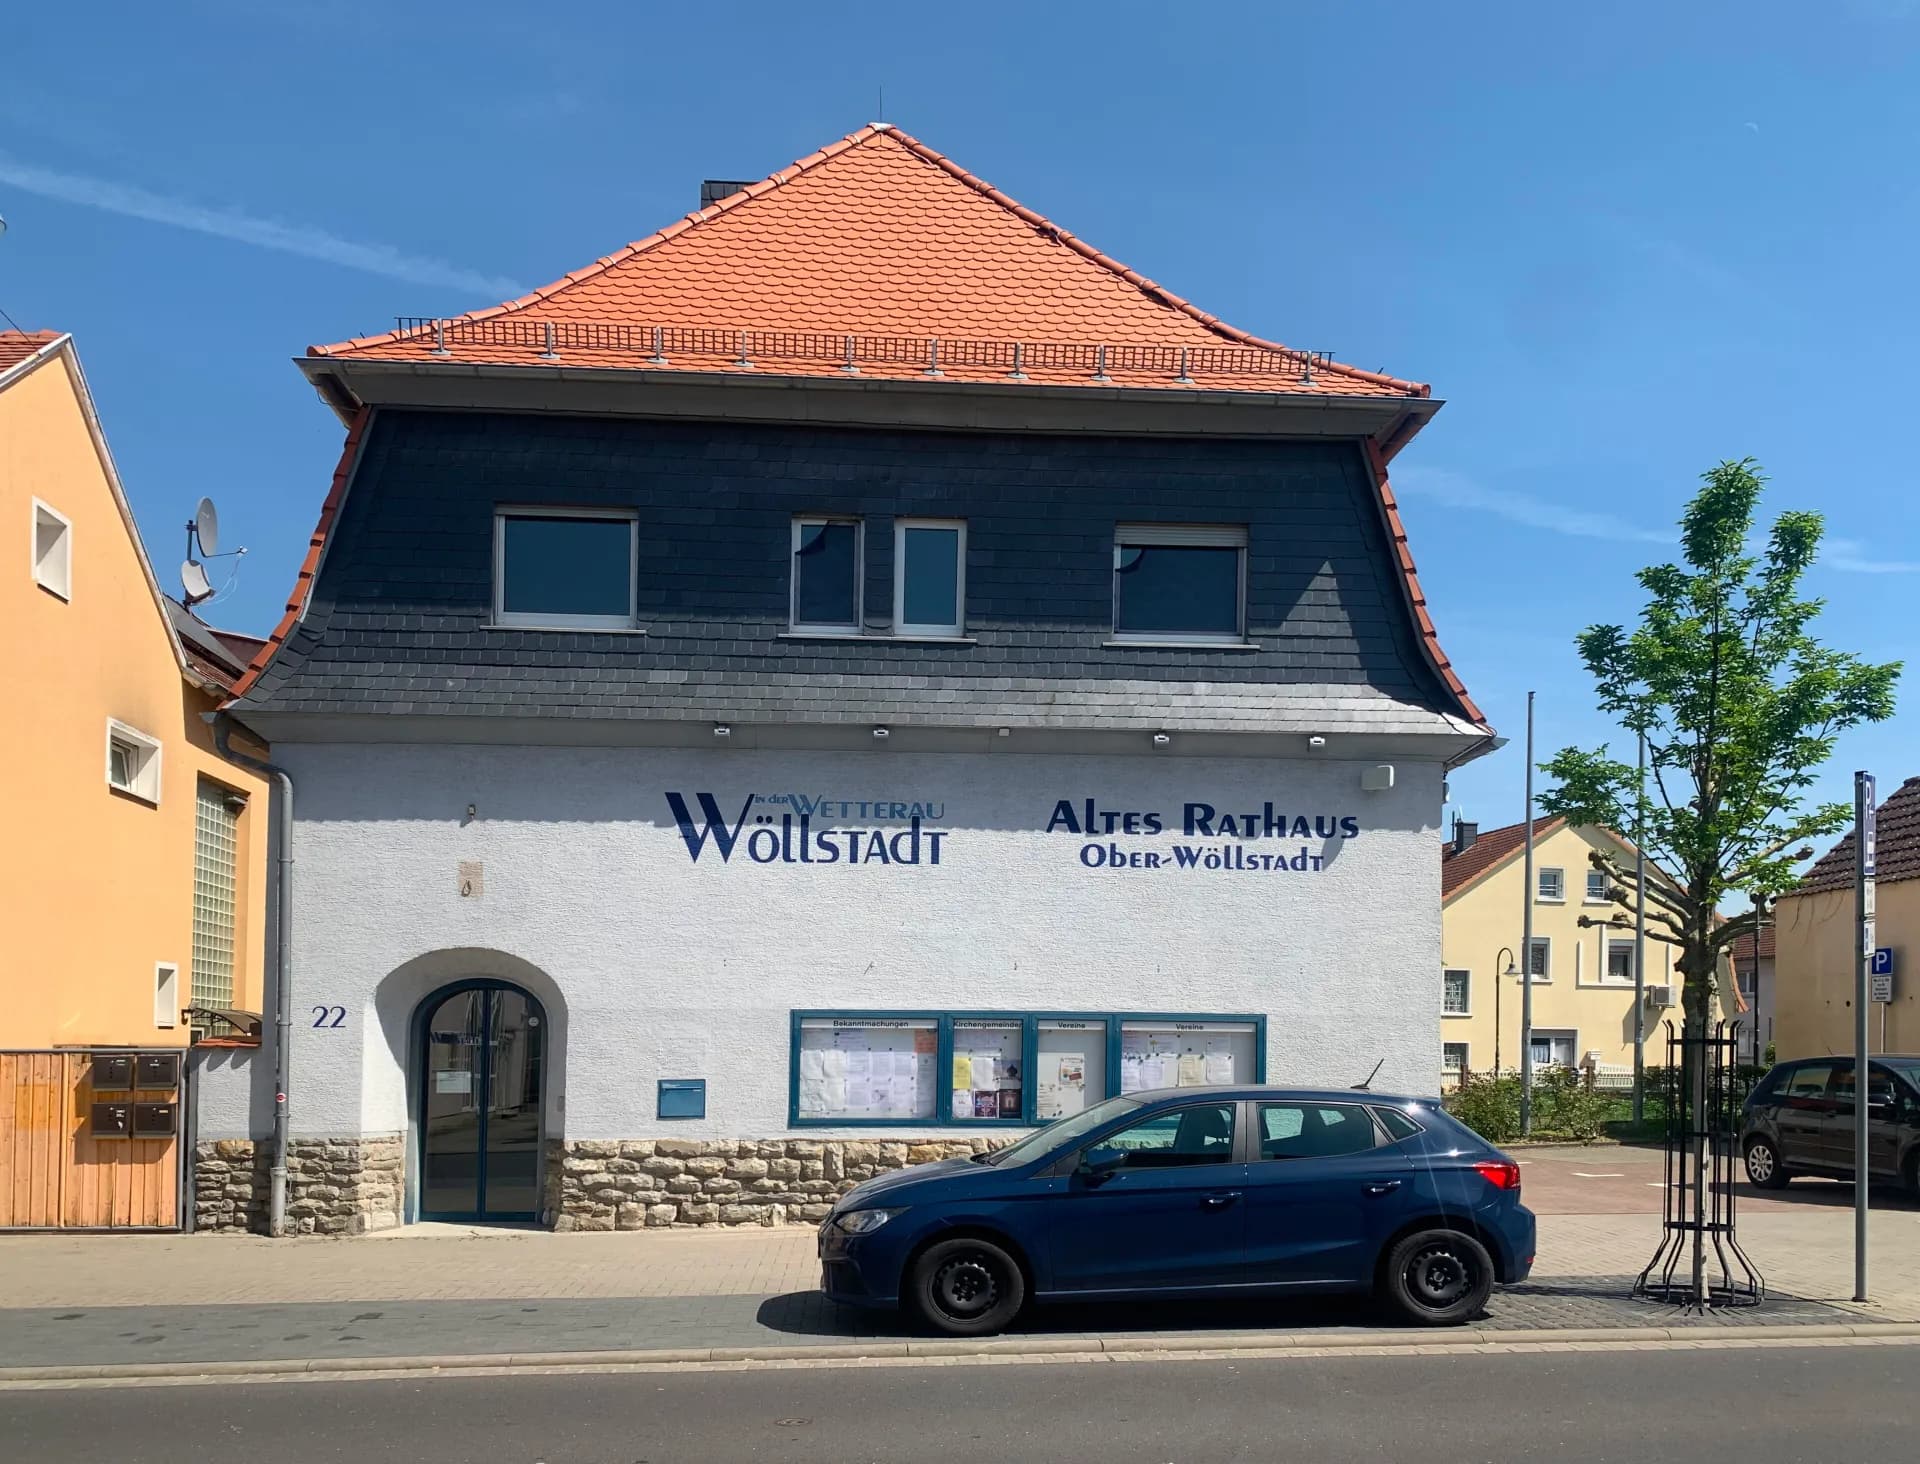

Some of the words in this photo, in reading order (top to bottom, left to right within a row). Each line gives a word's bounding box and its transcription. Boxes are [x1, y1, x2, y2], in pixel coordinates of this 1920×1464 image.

[1876, 951, 1888, 972] P
[312, 1005, 346, 1028] 22
[833, 1020, 909, 1029] Bekanntmachungen
[1057, 1021, 1086, 1029] Vereine
